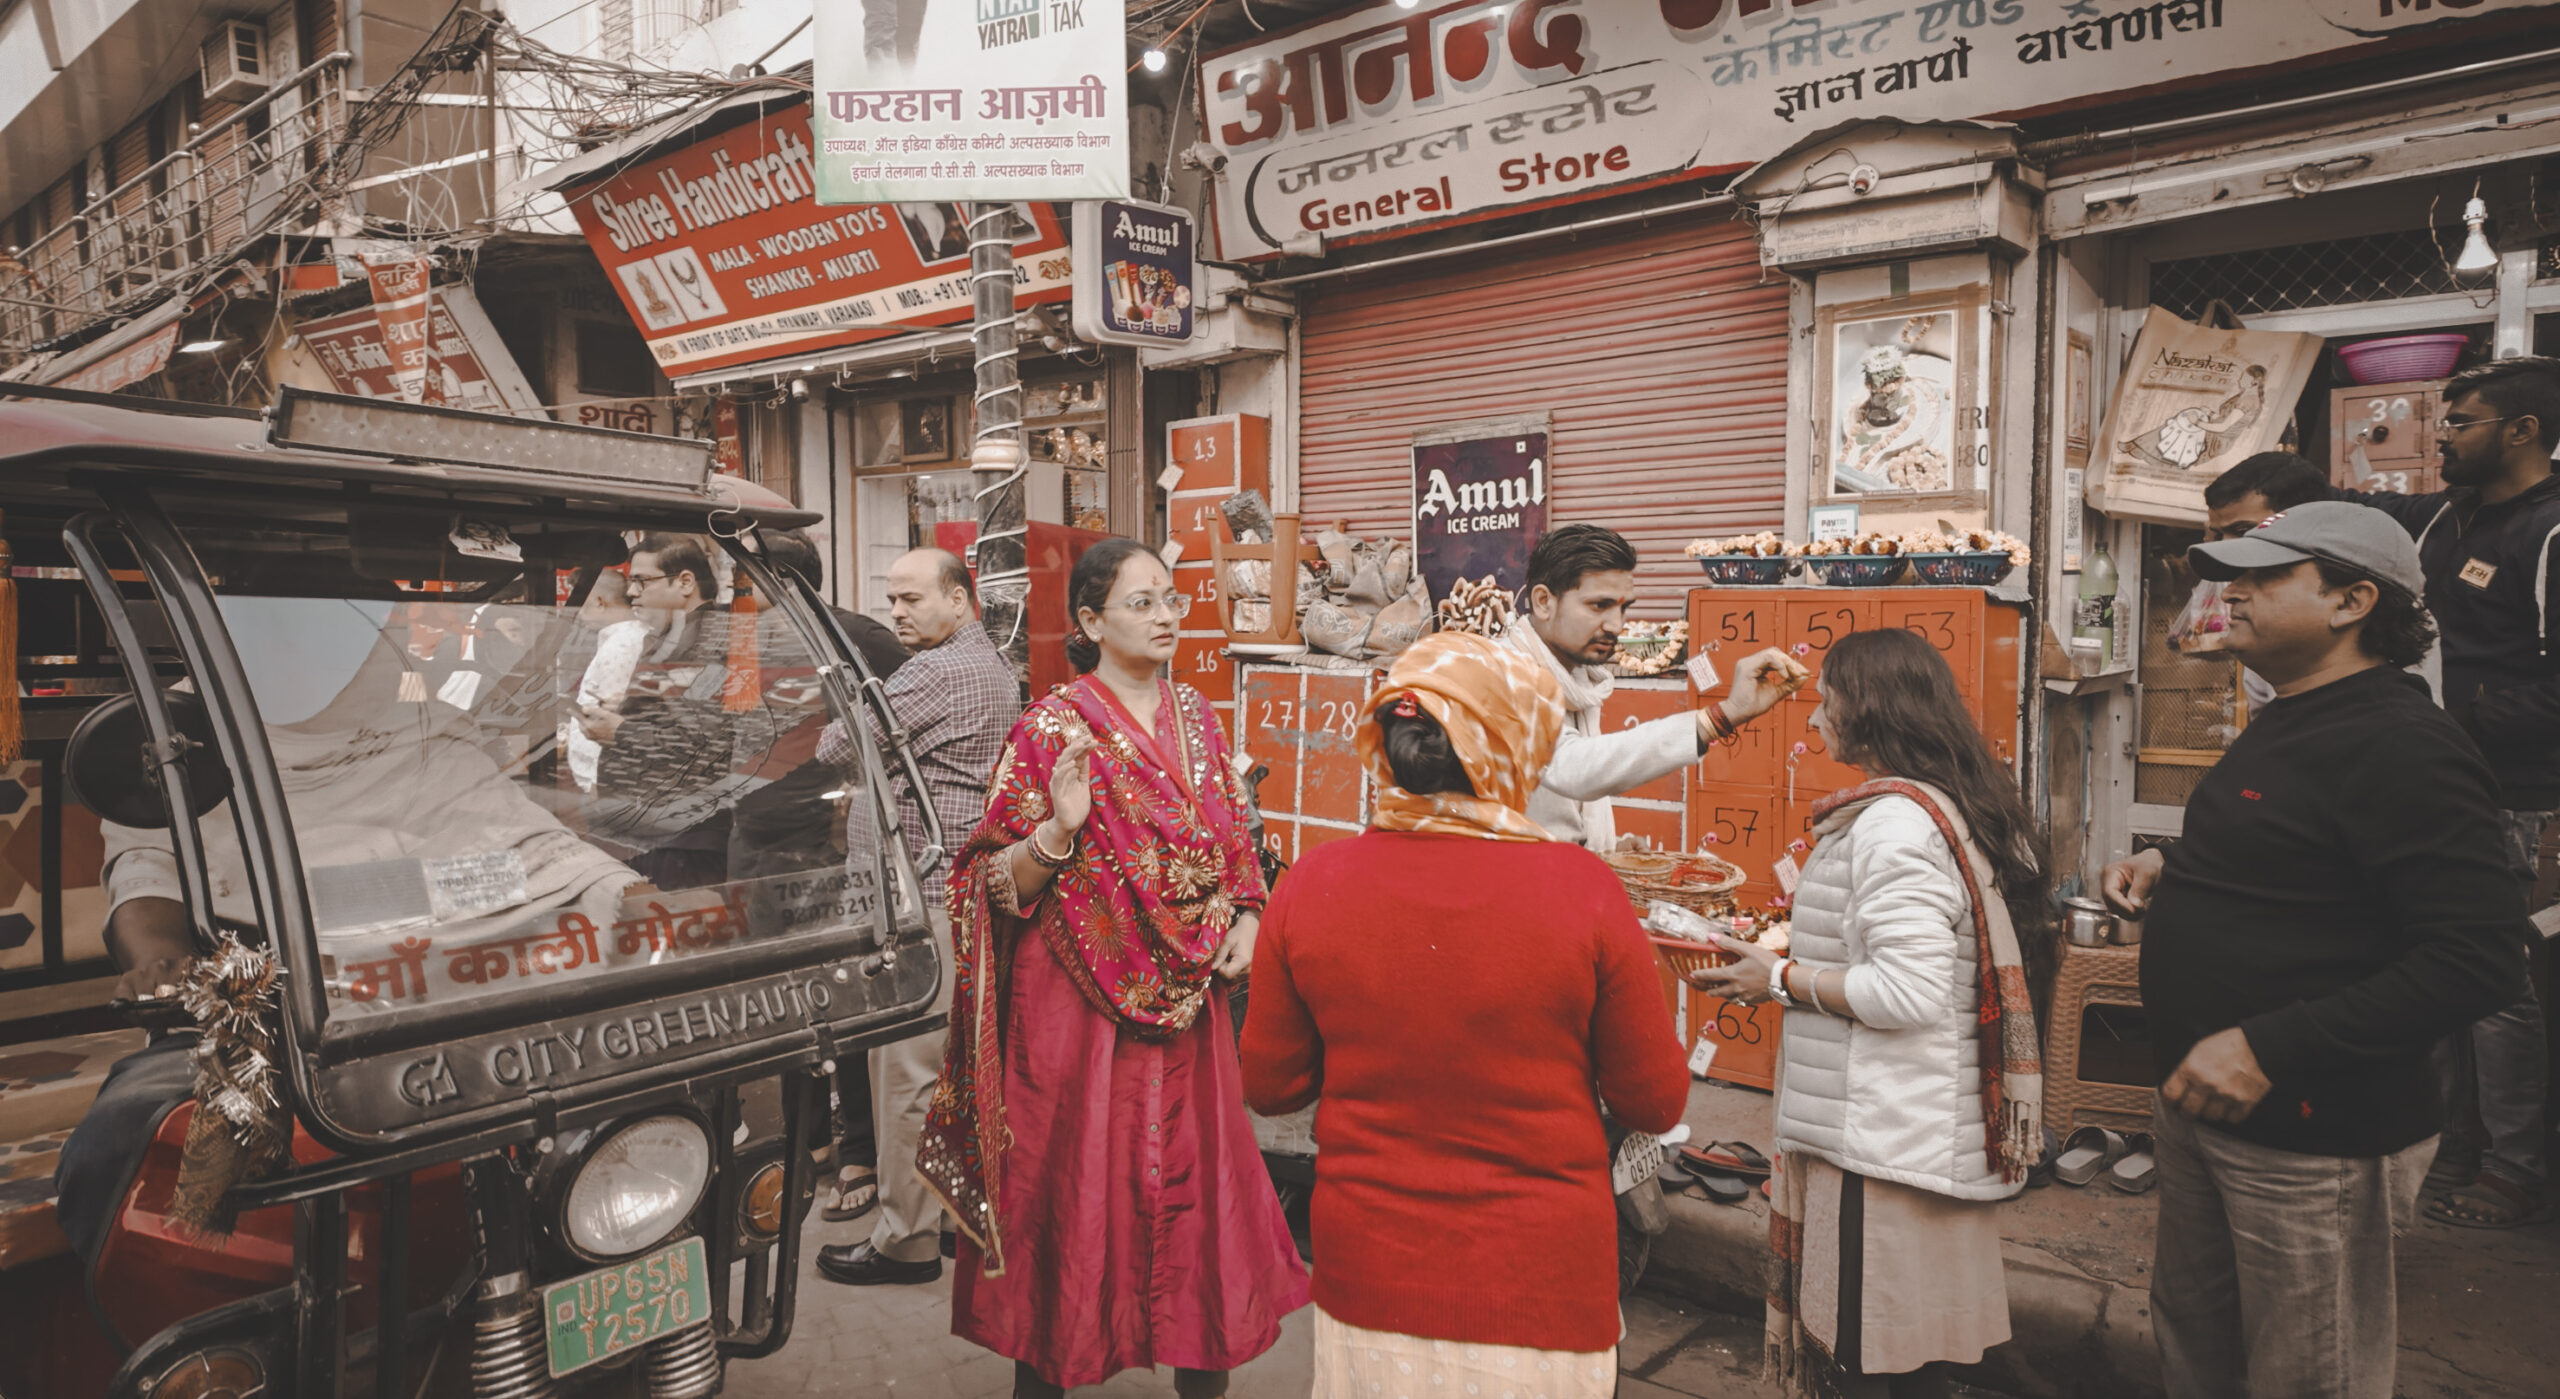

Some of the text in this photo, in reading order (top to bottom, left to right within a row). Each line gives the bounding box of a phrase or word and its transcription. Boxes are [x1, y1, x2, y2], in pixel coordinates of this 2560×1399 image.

[978, 15, 1028, 50] YATRA
[1050, 0, 1084, 32] TAK
[826, 74, 1107, 125] फरहान आज़मी
[971, 132, 1005, 150] कमिटी
[1077, 130, 1110, 148] विभाग
[1278, 83, 1658, 195] जनरल स्टोर
[1051, 159, 1084, 177] विभाग
[1300, 144, 1631, 232] General Store
[592, 190, 678, 252] Shree
[708, 245, 755, 272] MALA
[757, 220, 840, 259] WOODEN
[835, 206, 887, 239] TOYS
[1113, 210, 1180, 248] Amul
[1128, 241, 1167, 256] ICE CREAM
[745, 265, 816, 299] SHANKH
[822, 248, 881, 282] MURTI
[687, 334, 715, 354] FRONT
[728, 326, 749, 344] GATE
[825, 299, 877, 325] VARANASI
[1194, 436, 1217, 462] 13
[1418, 458, 1546, 520] Amul
[1447, 513, 1519, 534] ICE CREAM
[1196, 579, 1217, 602] 15
[1722, 609, 1761, 643] 51
[1196, 650, 1218, 673] 16
[1260, 700, 1357, 741] 27 28
[1715, 807, 1759, 848] 57
[344, 936, 432, 1002] माँ
[442, 911, 600, 985] काली
[488, 1025, 594, 1087] CITY
[598, 997, 736, 1061] GREEN
[738, 977, 832, 1031] AUTO
[1717, 1001, 1761, 1044] 63
[578, 1248, 689, 1318] UP65N
[557, 1288, 690, 1359] IND T2570
